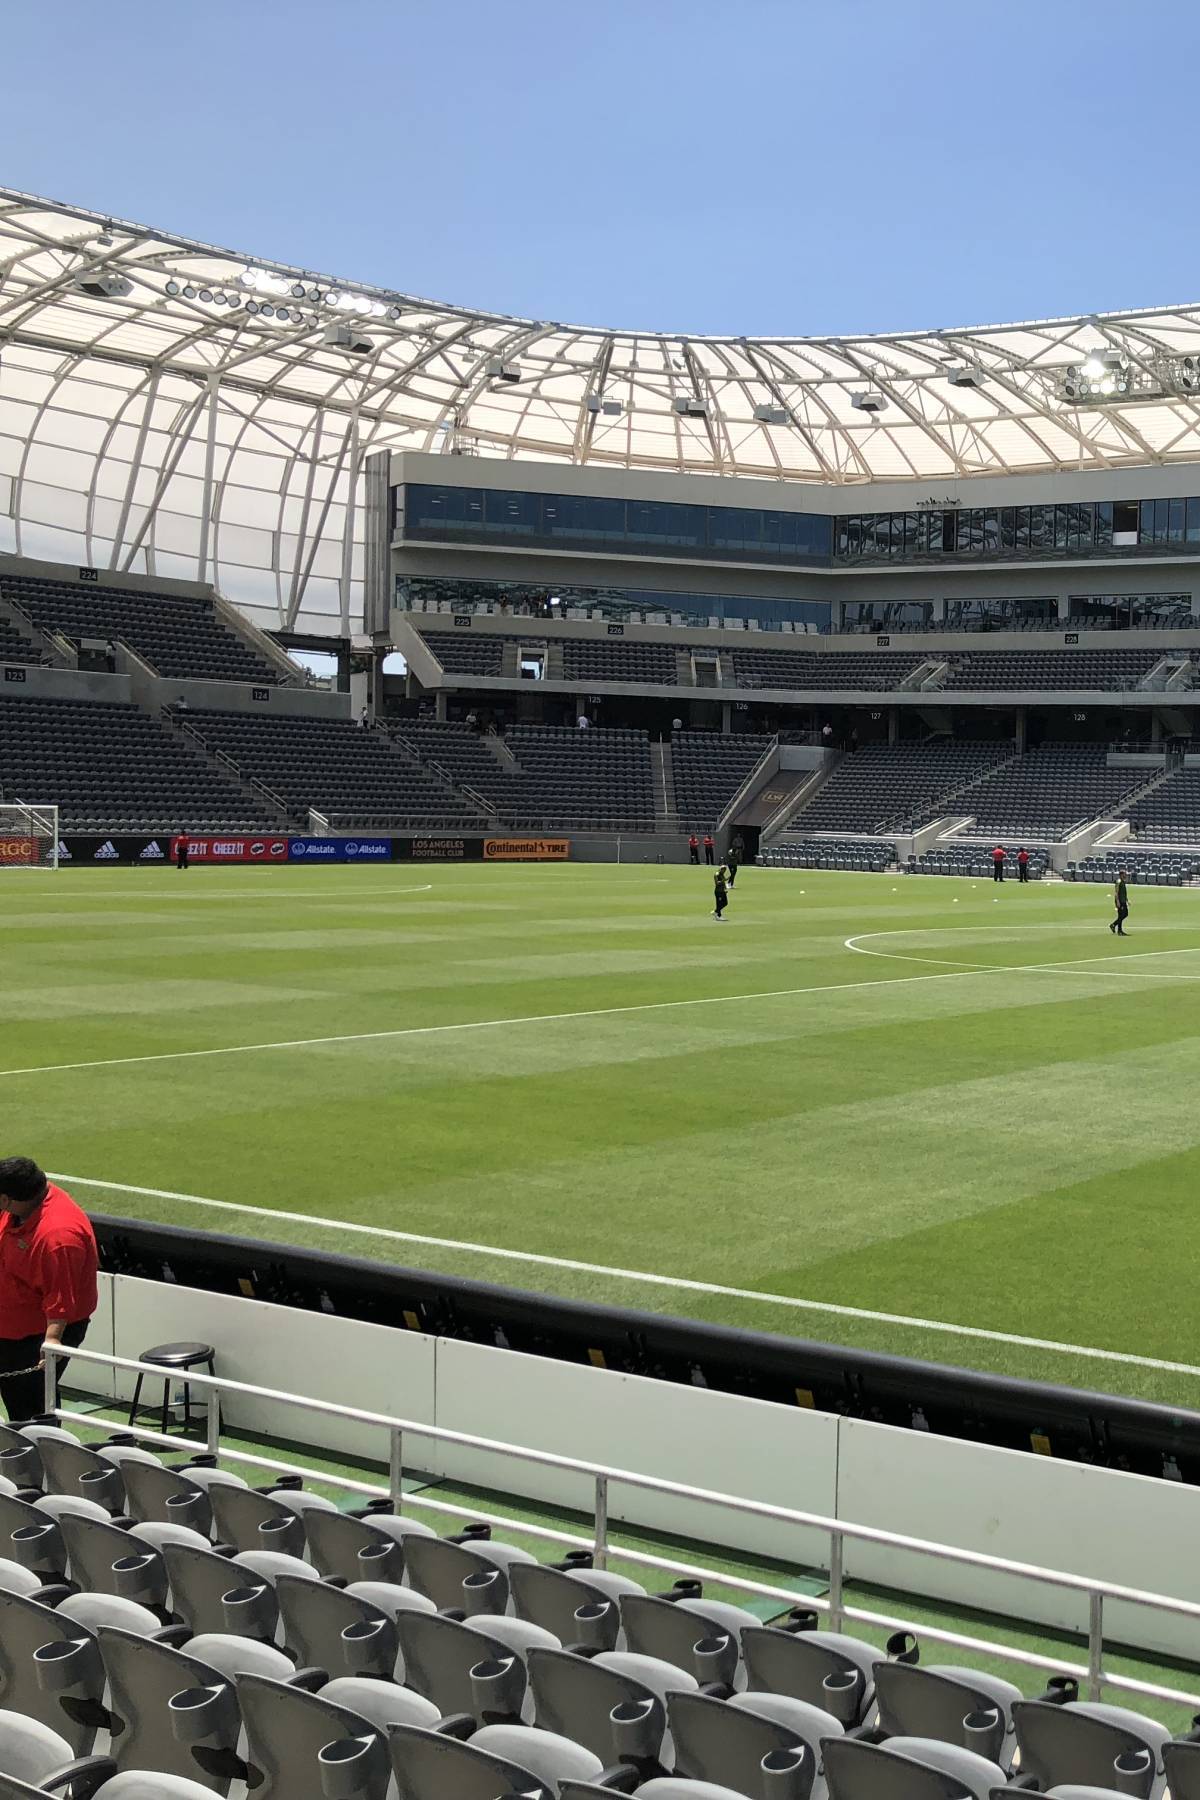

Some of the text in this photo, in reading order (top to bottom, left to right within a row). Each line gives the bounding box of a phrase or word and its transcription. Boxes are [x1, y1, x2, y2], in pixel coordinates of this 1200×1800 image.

[412, 840, 465, 849] LOS ANGELES
[485, 841, 567, 856] Continental TIRE
[412, 849, 464, 857] FOOTBALL CLUB
